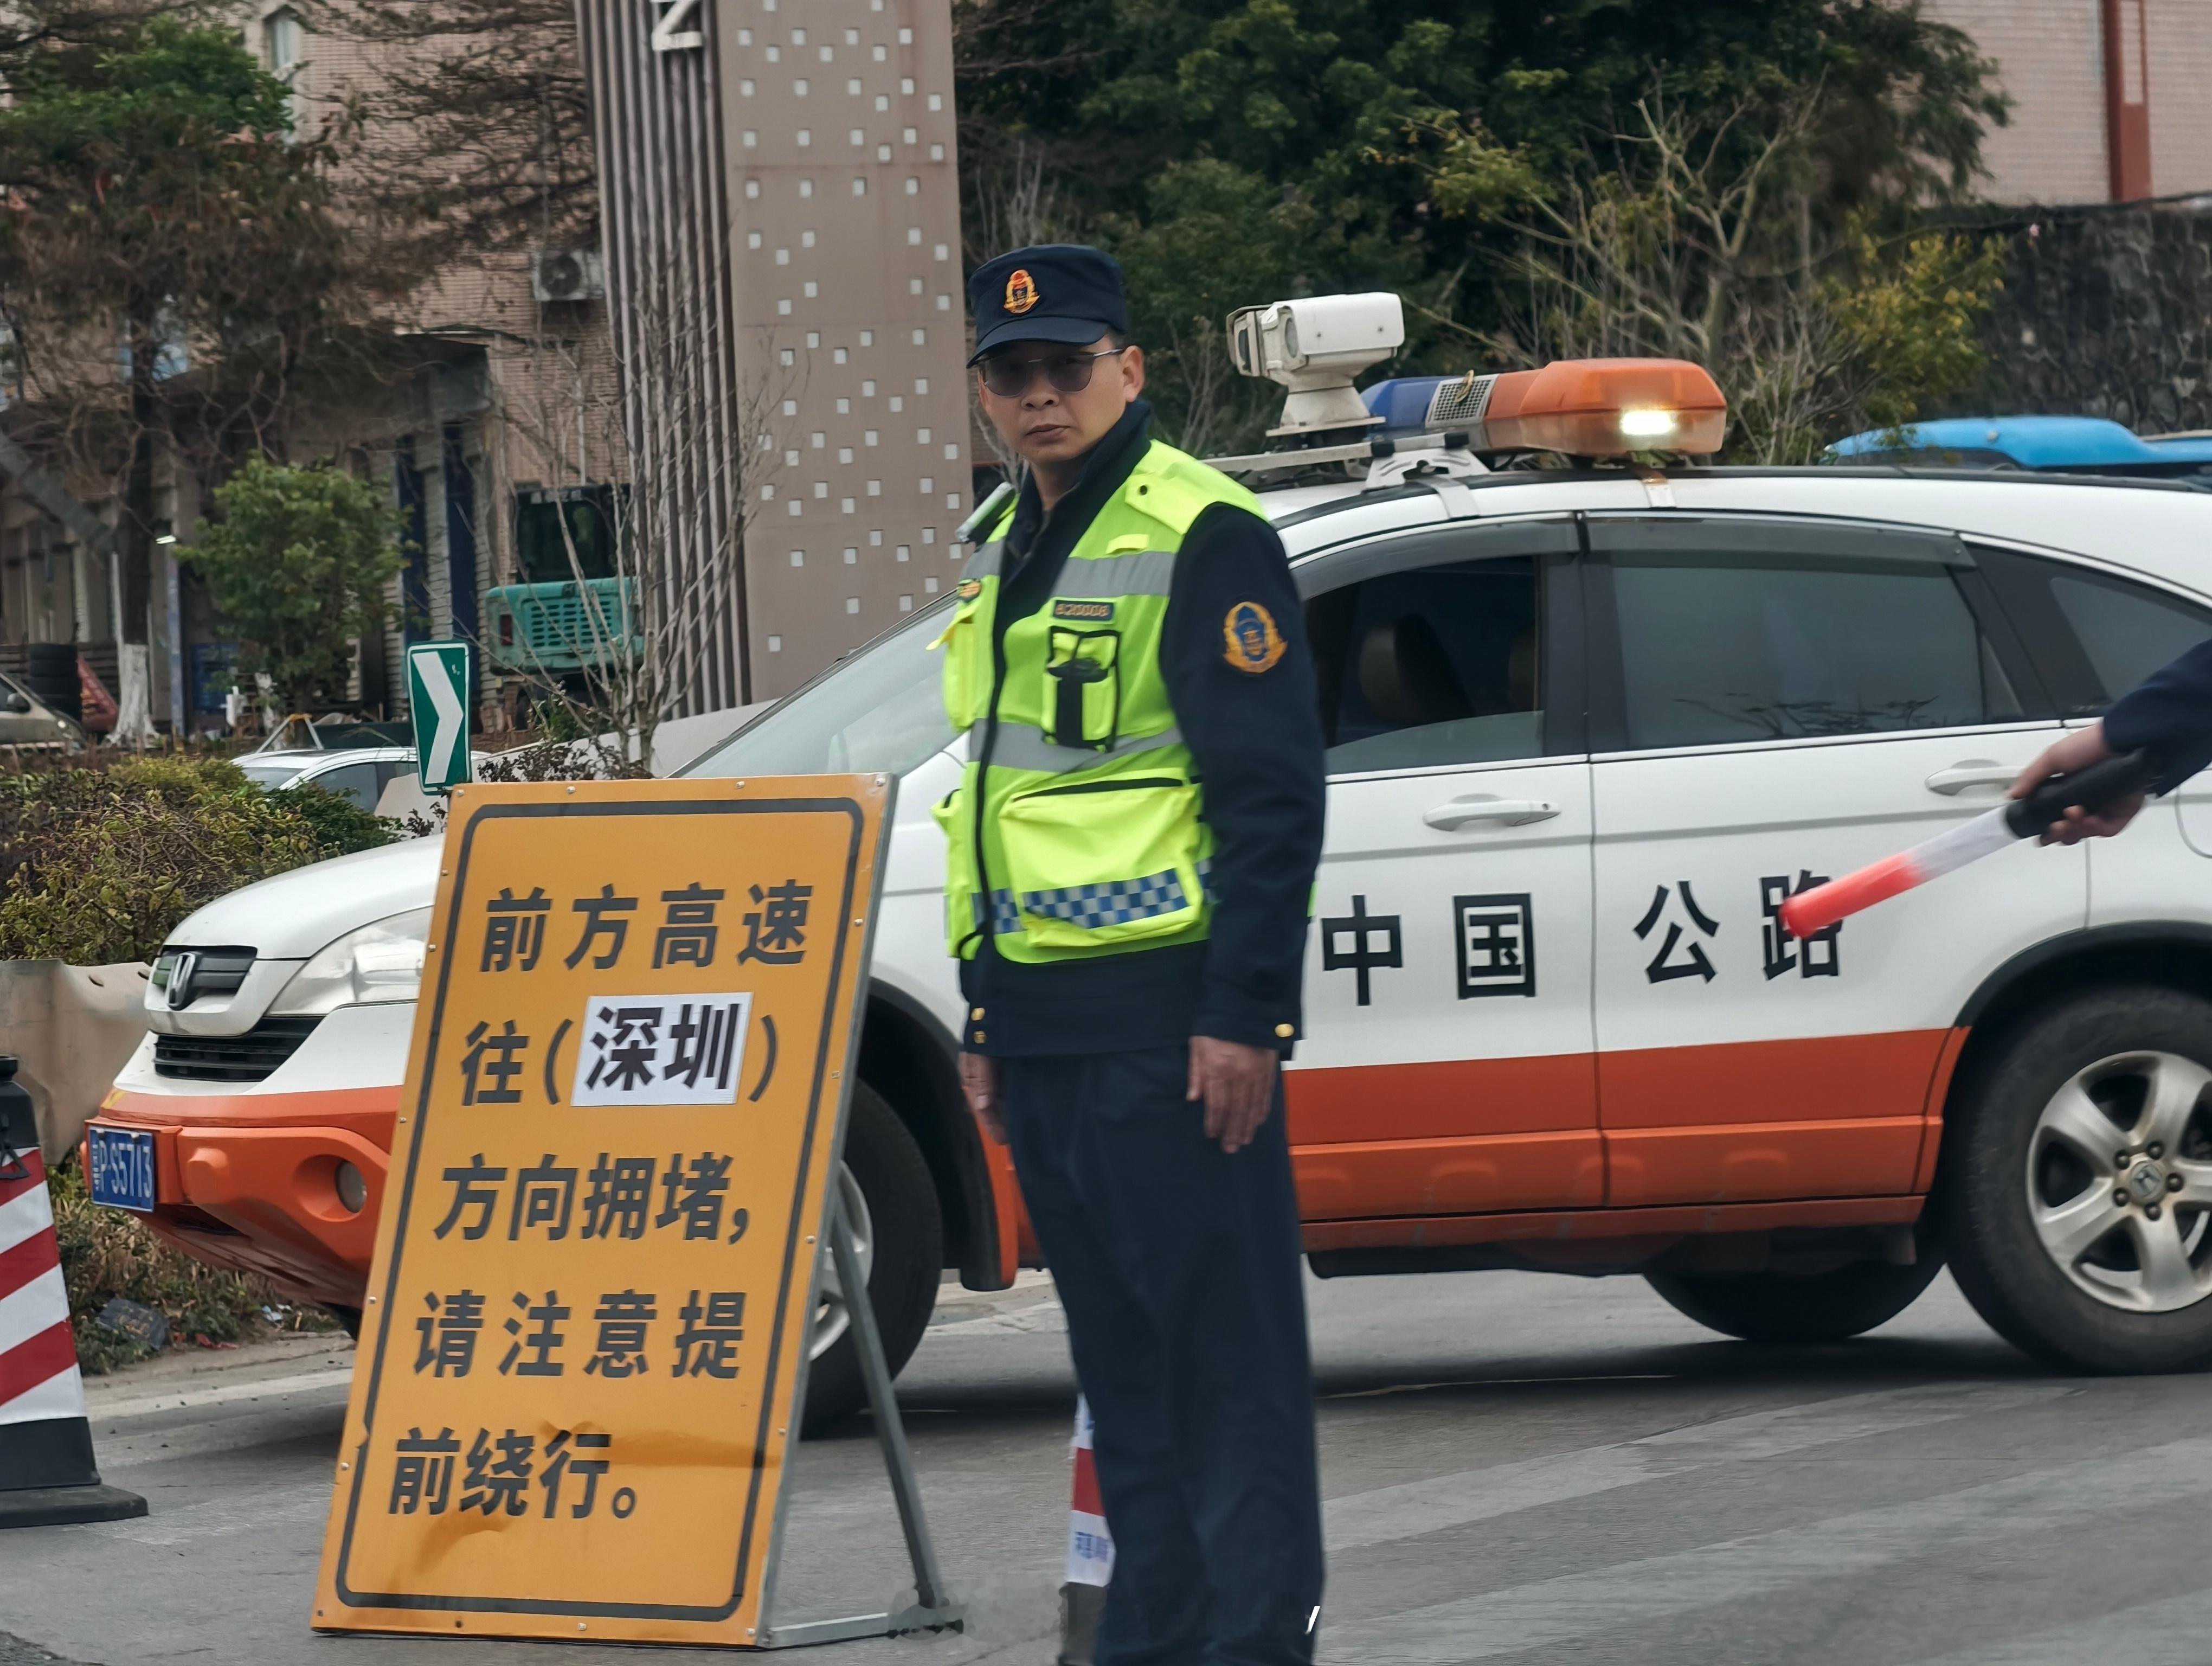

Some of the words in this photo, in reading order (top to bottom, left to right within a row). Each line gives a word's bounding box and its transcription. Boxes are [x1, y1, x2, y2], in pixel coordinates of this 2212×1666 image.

[479, 878, 813, 973] 前方高速
[460, 1003, 777, 1107] 往（深圳）
[433, 1151, 750, 1246] 方向拥堵，
[414, 1288, 747, 1380] 请注意提
[388, 1426, 636, 1520] 前绕行。
